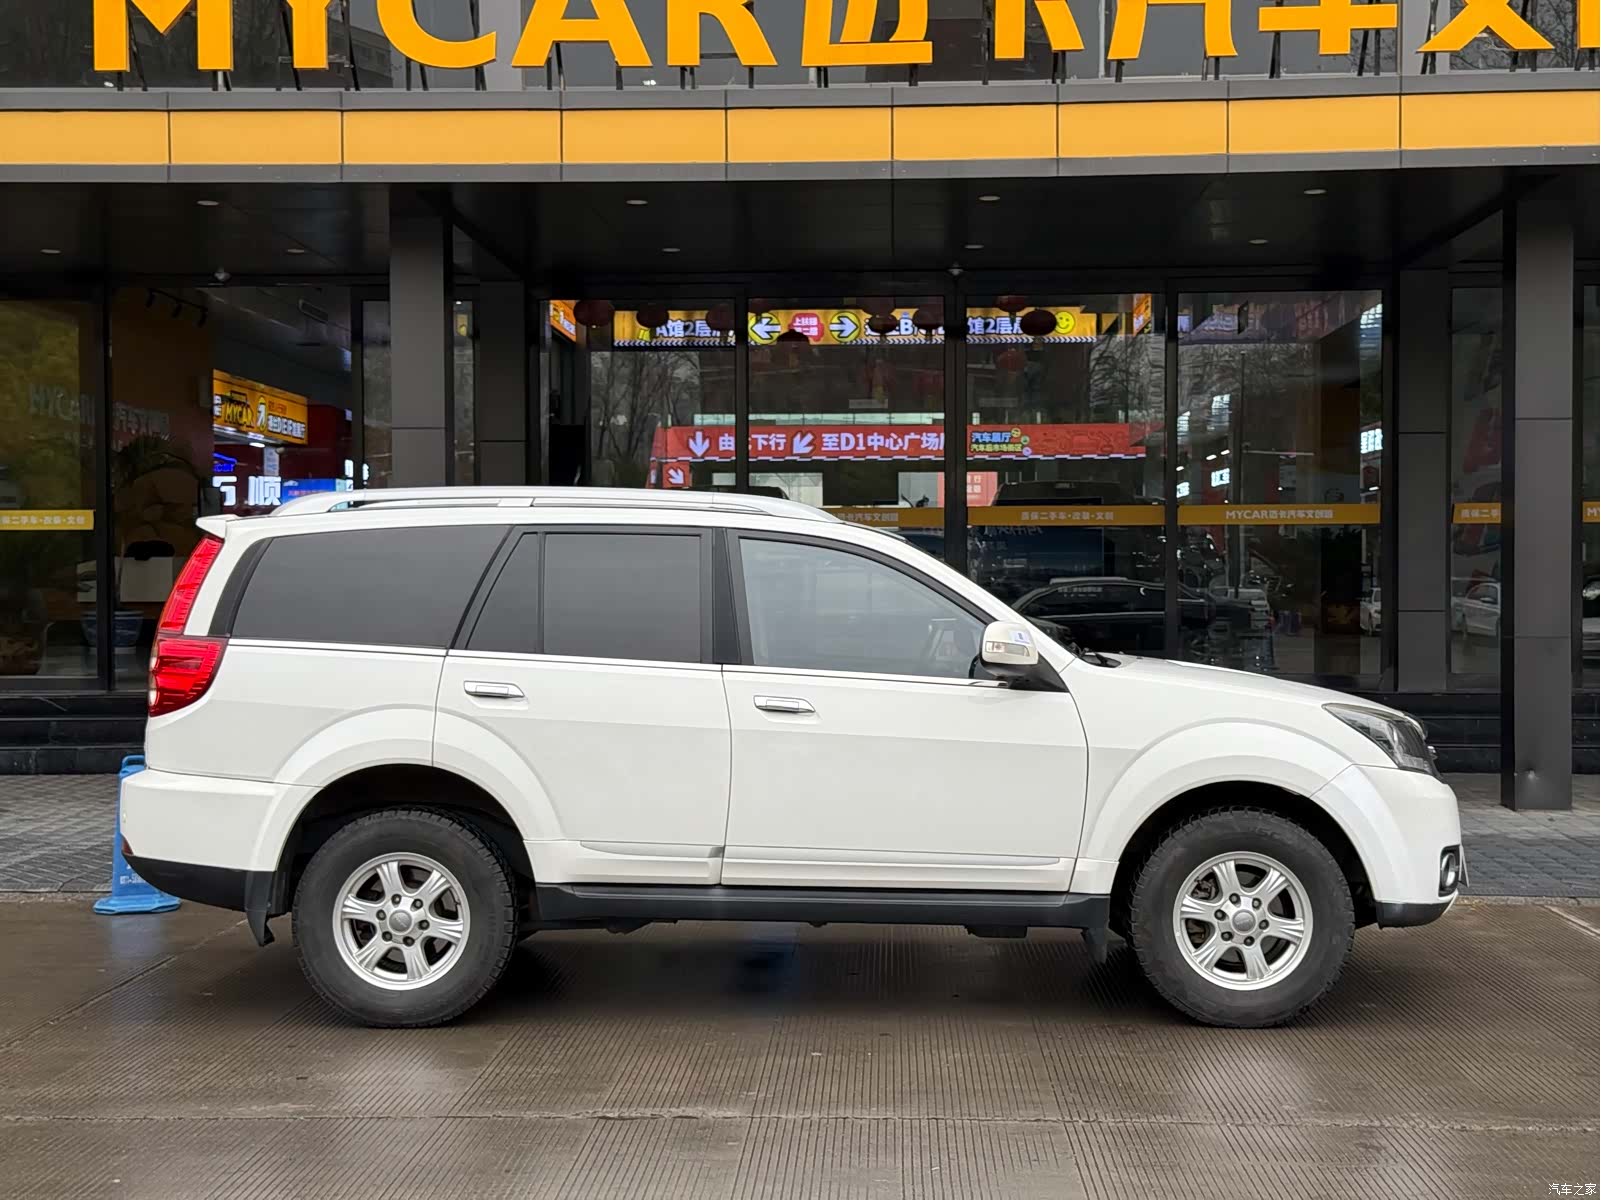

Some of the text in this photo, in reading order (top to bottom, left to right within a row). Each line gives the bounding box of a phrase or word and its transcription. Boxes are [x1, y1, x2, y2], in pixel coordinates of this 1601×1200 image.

[656, 319, 720, 337] A馆2层
[719, 432, 945, 452] 由下行 至D1中心广场
